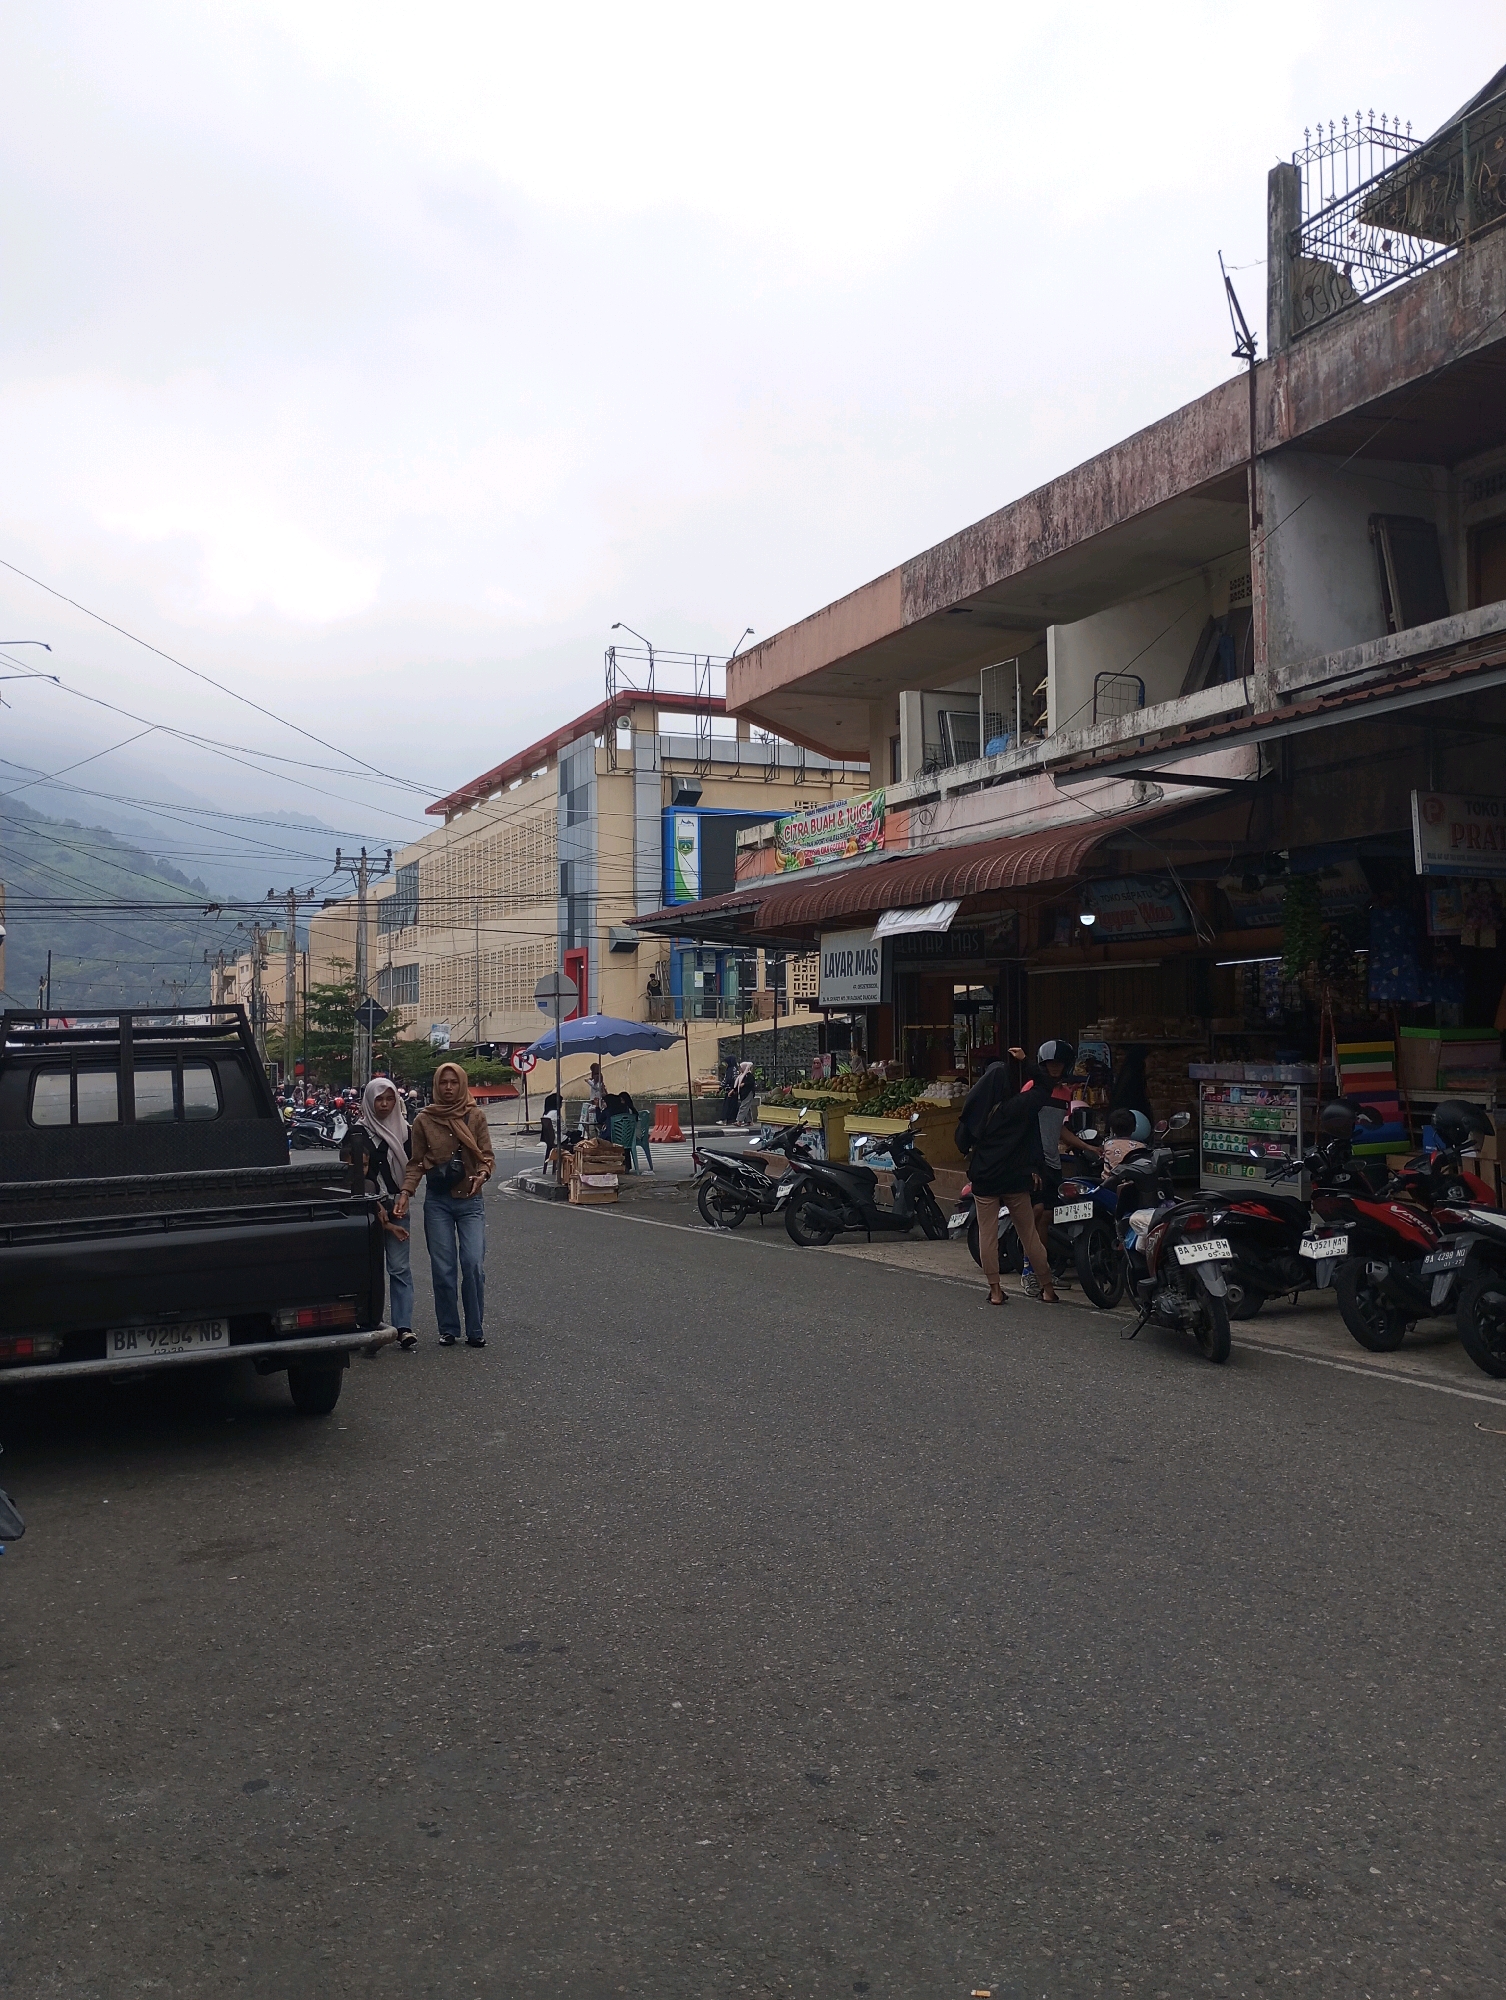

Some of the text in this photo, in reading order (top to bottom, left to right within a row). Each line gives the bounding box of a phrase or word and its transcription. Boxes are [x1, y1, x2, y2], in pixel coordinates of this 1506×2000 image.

[1465, 800, 1499, 817] TOKO
[784, 820, 809, 842] CITRA
[811, 812, 836, 836] BUAH
[838, 809, 845, 827] &
[846, 800, 873, 828] JUICE
[1100, 889, 1153, 903] TOKO SEPATU
[951, 932, 979, 952] MAS
[824, 947, 878, 978] LAYAR MAS
[1055, 1207, 1063, 1216] BA
[1390, 1205, 1434, 1236] VARIO
[1178, 1246, 1190, 1255] BA
[1424, 1255, 1434, 1264] BA
[113, 1322, 223, 1351] BA 9204 NB
